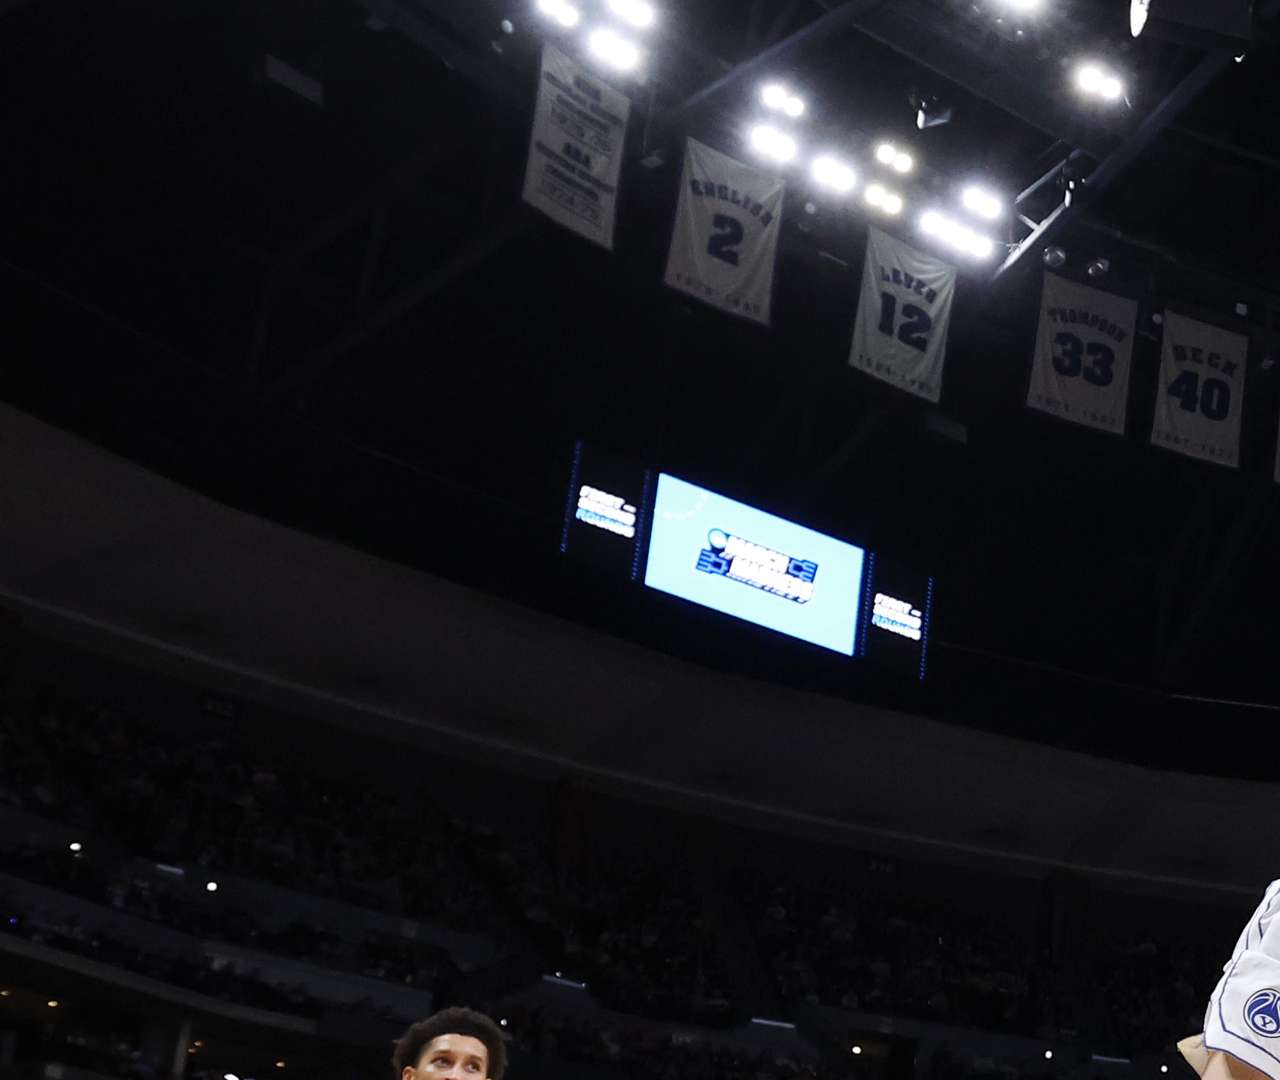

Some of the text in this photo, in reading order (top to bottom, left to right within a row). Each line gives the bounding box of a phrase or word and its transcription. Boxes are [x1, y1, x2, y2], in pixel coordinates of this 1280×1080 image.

[707, 213, 744, 267] 2
[878, 291, 933, 354] 12
[1052, 331, 1116, 388] 33
[1171, 344, 1239, 379] BECK
[1167, 369, 1232, 421] 40
